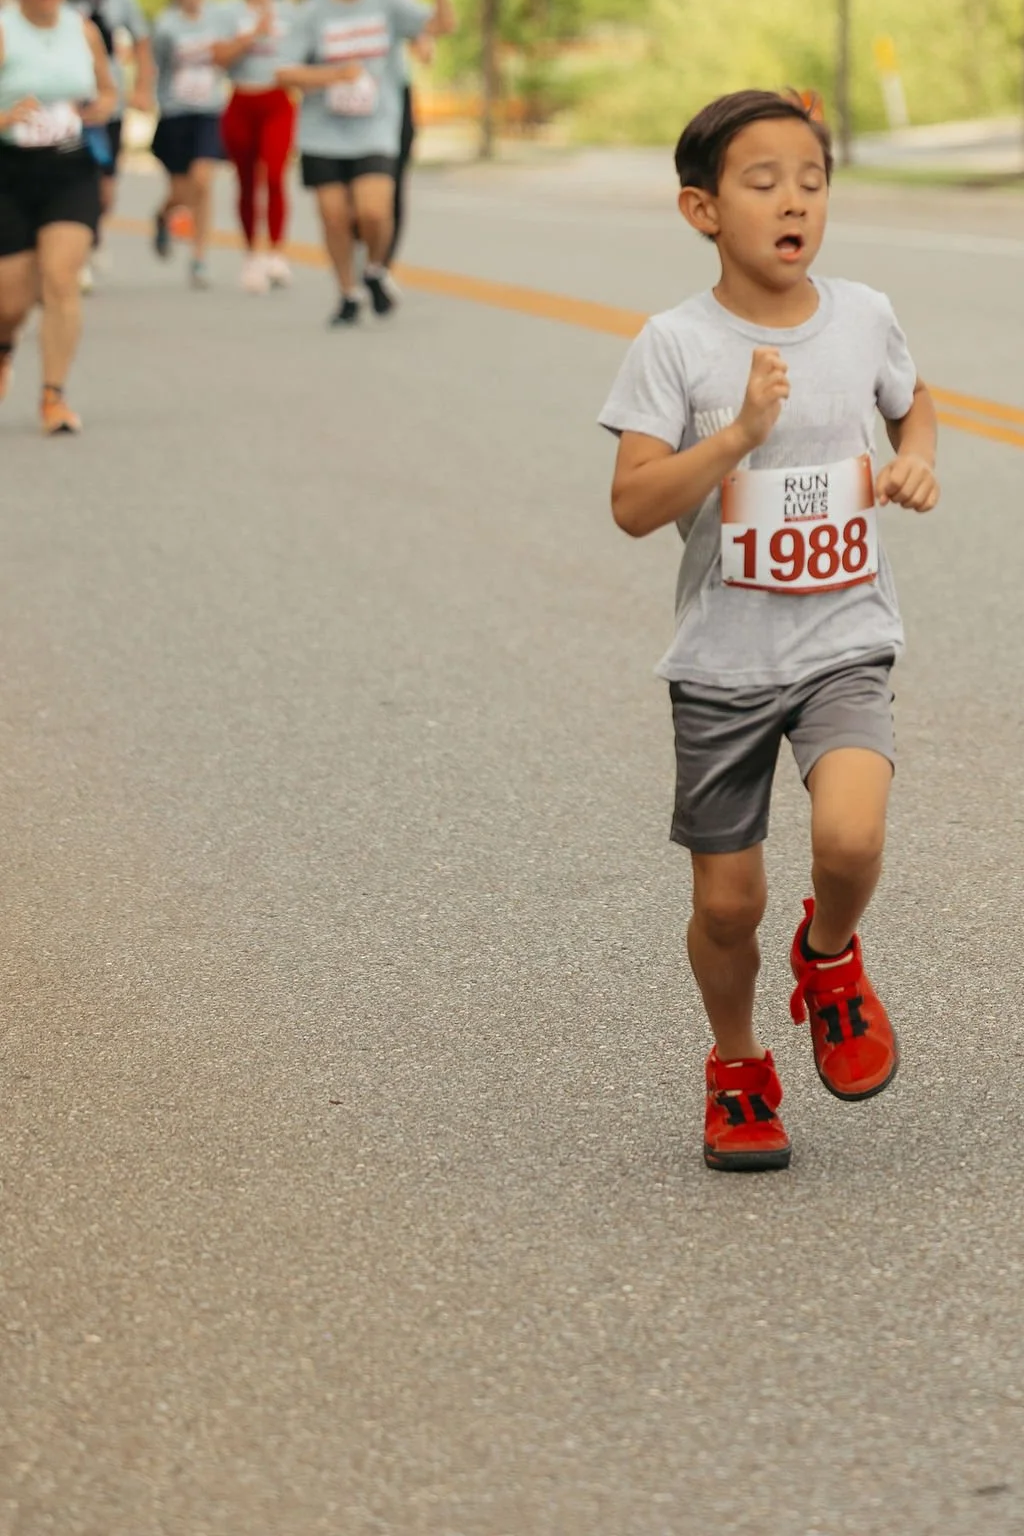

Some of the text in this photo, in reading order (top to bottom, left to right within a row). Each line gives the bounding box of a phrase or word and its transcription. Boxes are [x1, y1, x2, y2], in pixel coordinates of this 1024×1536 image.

[784, 473, 828, 492] RUN
[784, 500, 828, 515] LIVES
[733, 517, 869, 582] 1988
